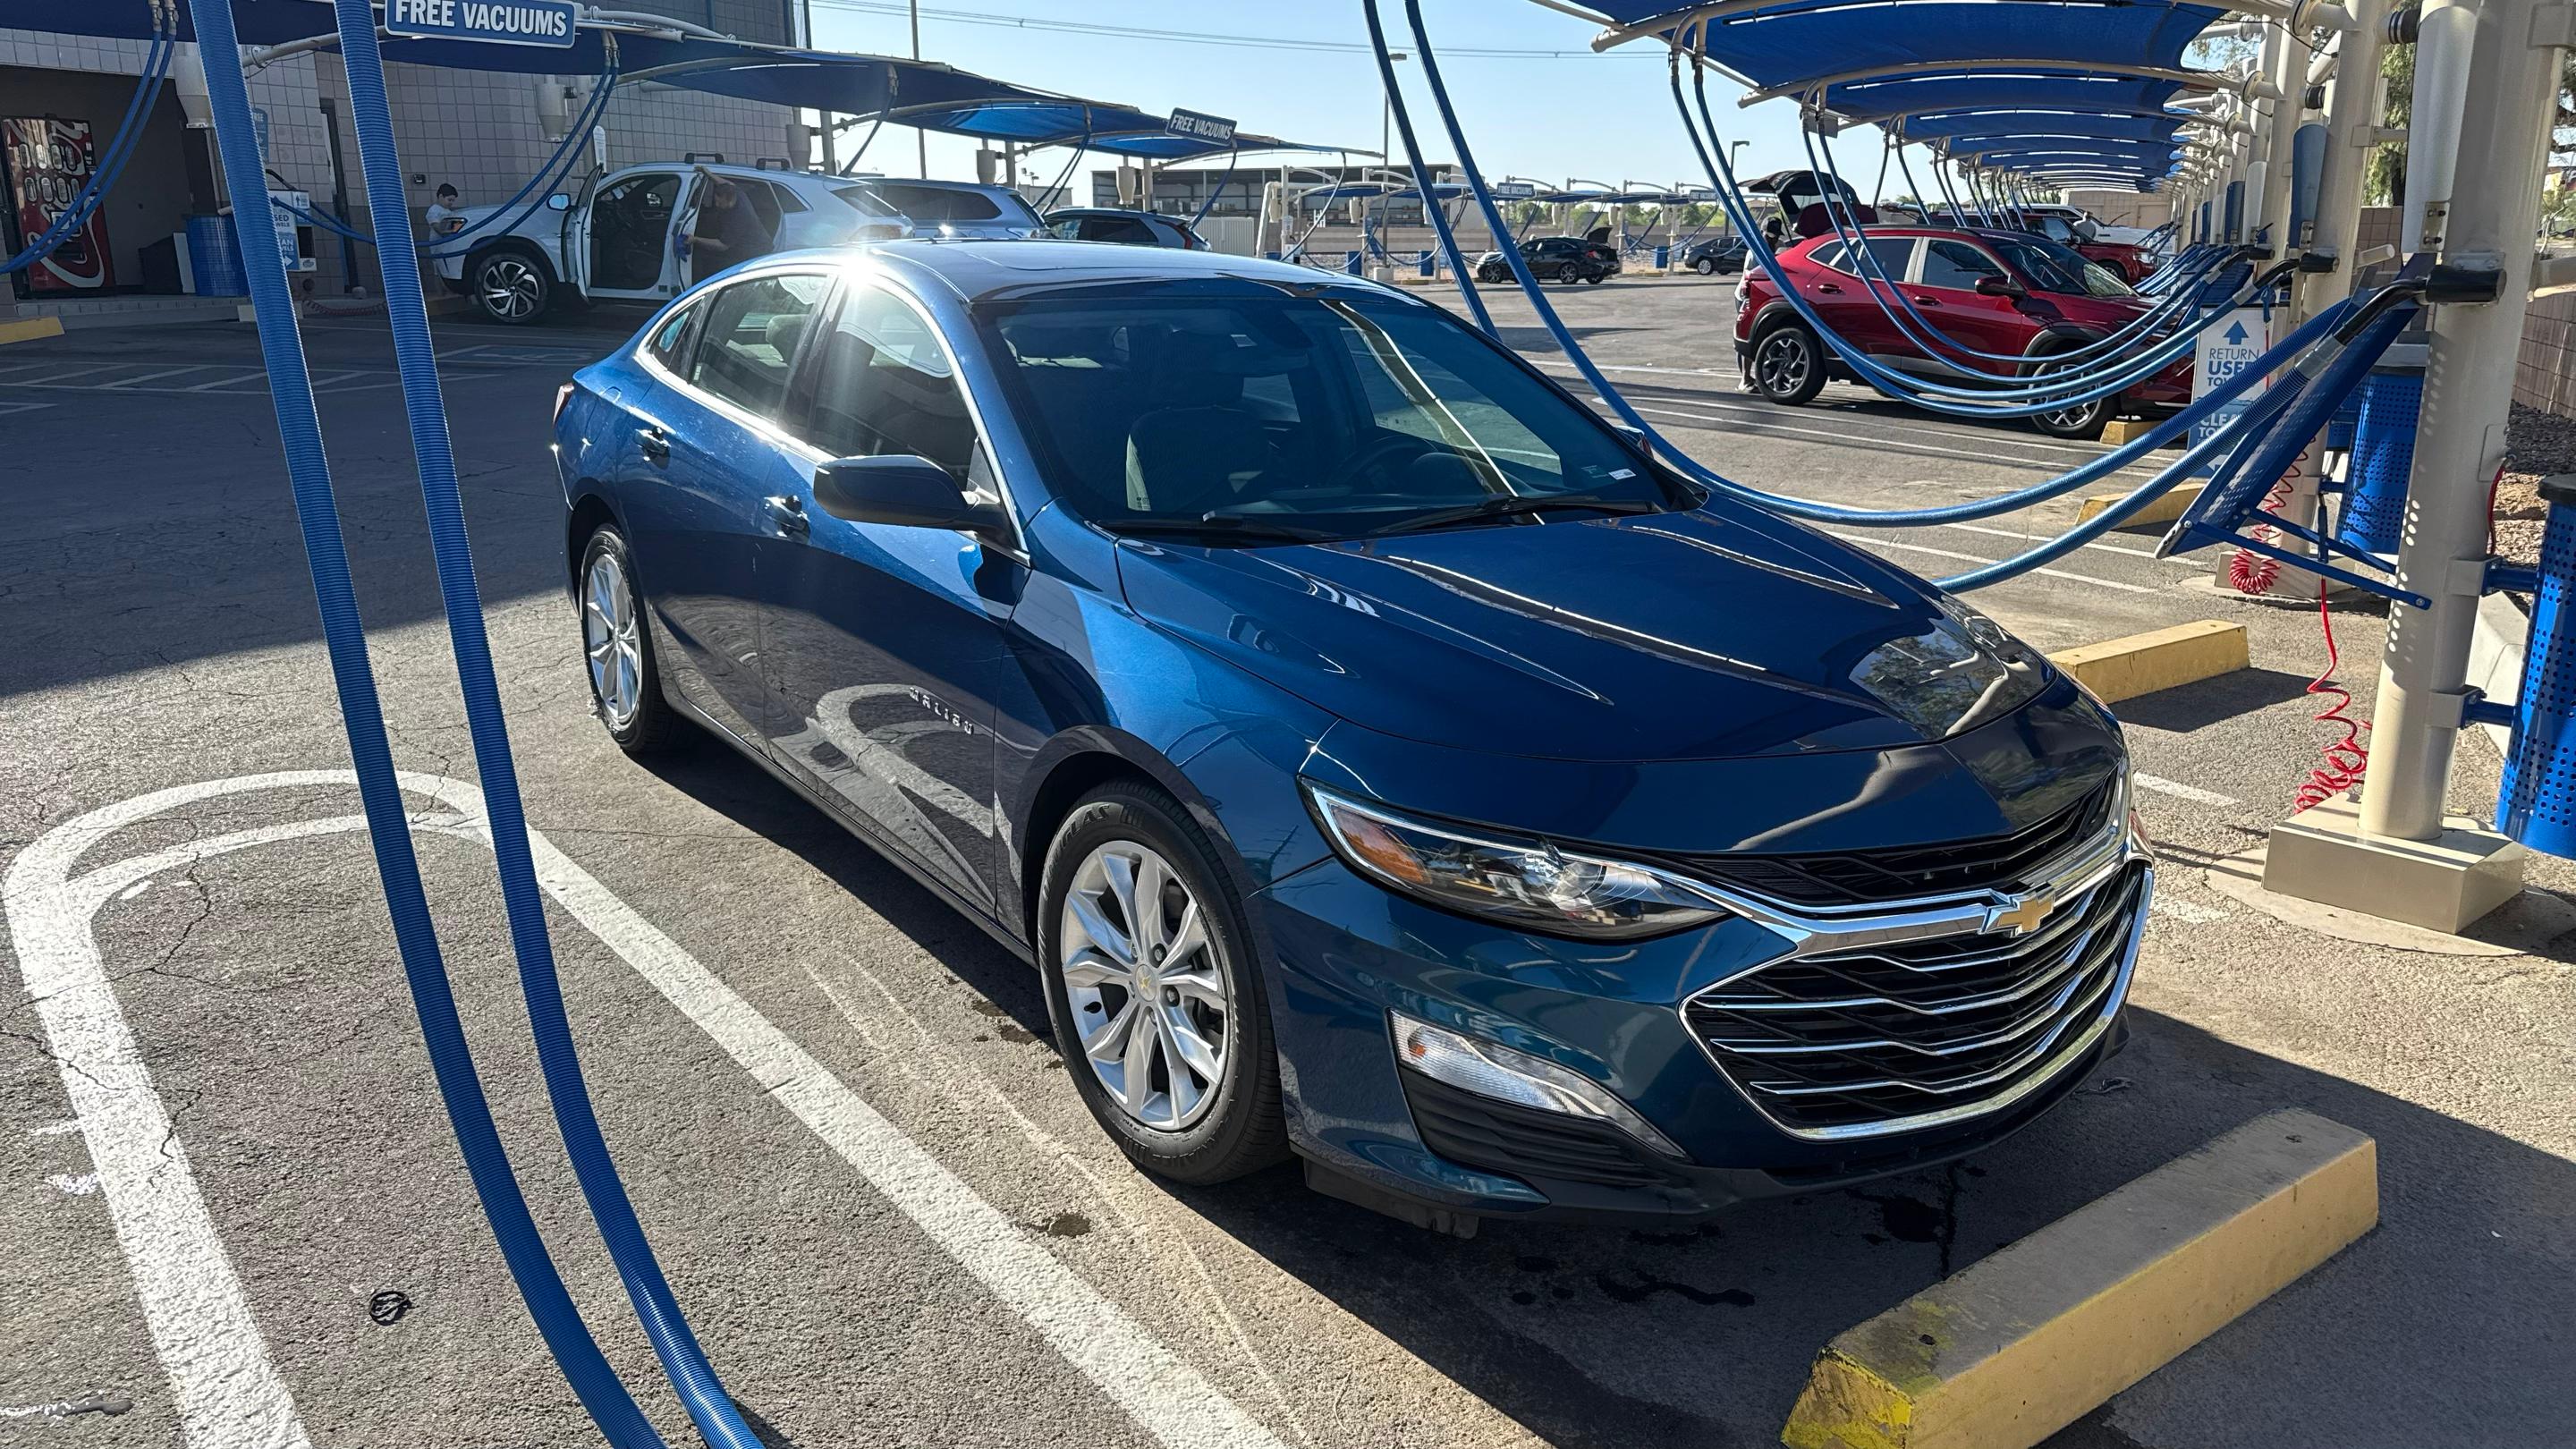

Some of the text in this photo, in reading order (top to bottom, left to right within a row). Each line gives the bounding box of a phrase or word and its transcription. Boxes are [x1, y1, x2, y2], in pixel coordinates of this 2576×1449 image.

[395, 0, 567, 37] FREE VACUUMS
[1170, 114, 1233, 140] FREE VACUUMS
[274, 214, 290, 222] SED
[2209, 348, 2259, 360] RETURN
[909, 687, 973, 735] MALIBU
